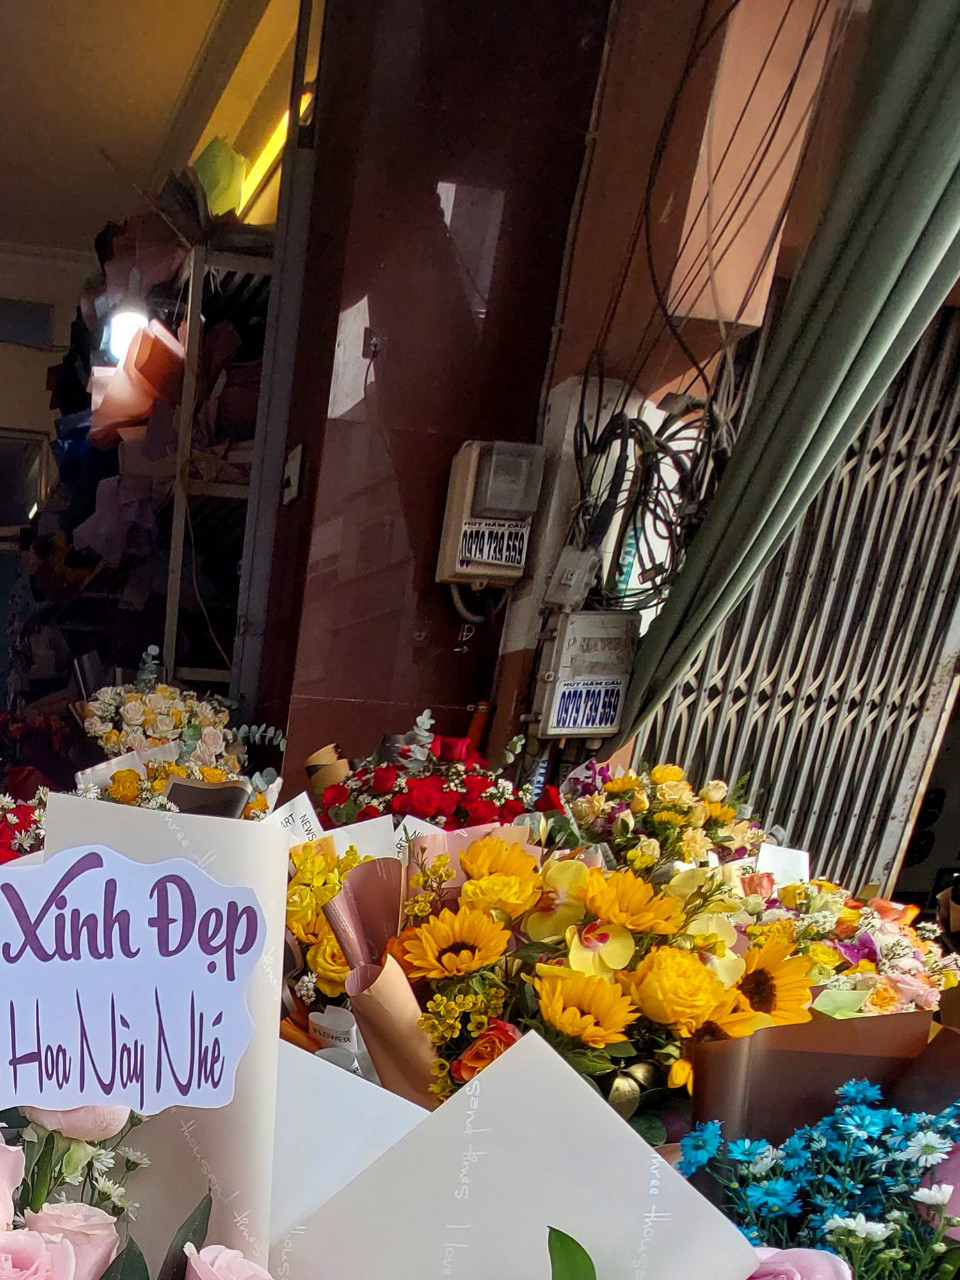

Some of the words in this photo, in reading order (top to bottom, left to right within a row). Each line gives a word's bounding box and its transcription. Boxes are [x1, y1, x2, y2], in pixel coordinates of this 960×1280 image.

[0, 851, 140, 964] Xinh
[147, 874, 258, 982] Đẹp
[8, 998, 72, 1095] Hoa
[76, 988, 145, 1110] Này
[154, 985, 226, 1097] Nhé
